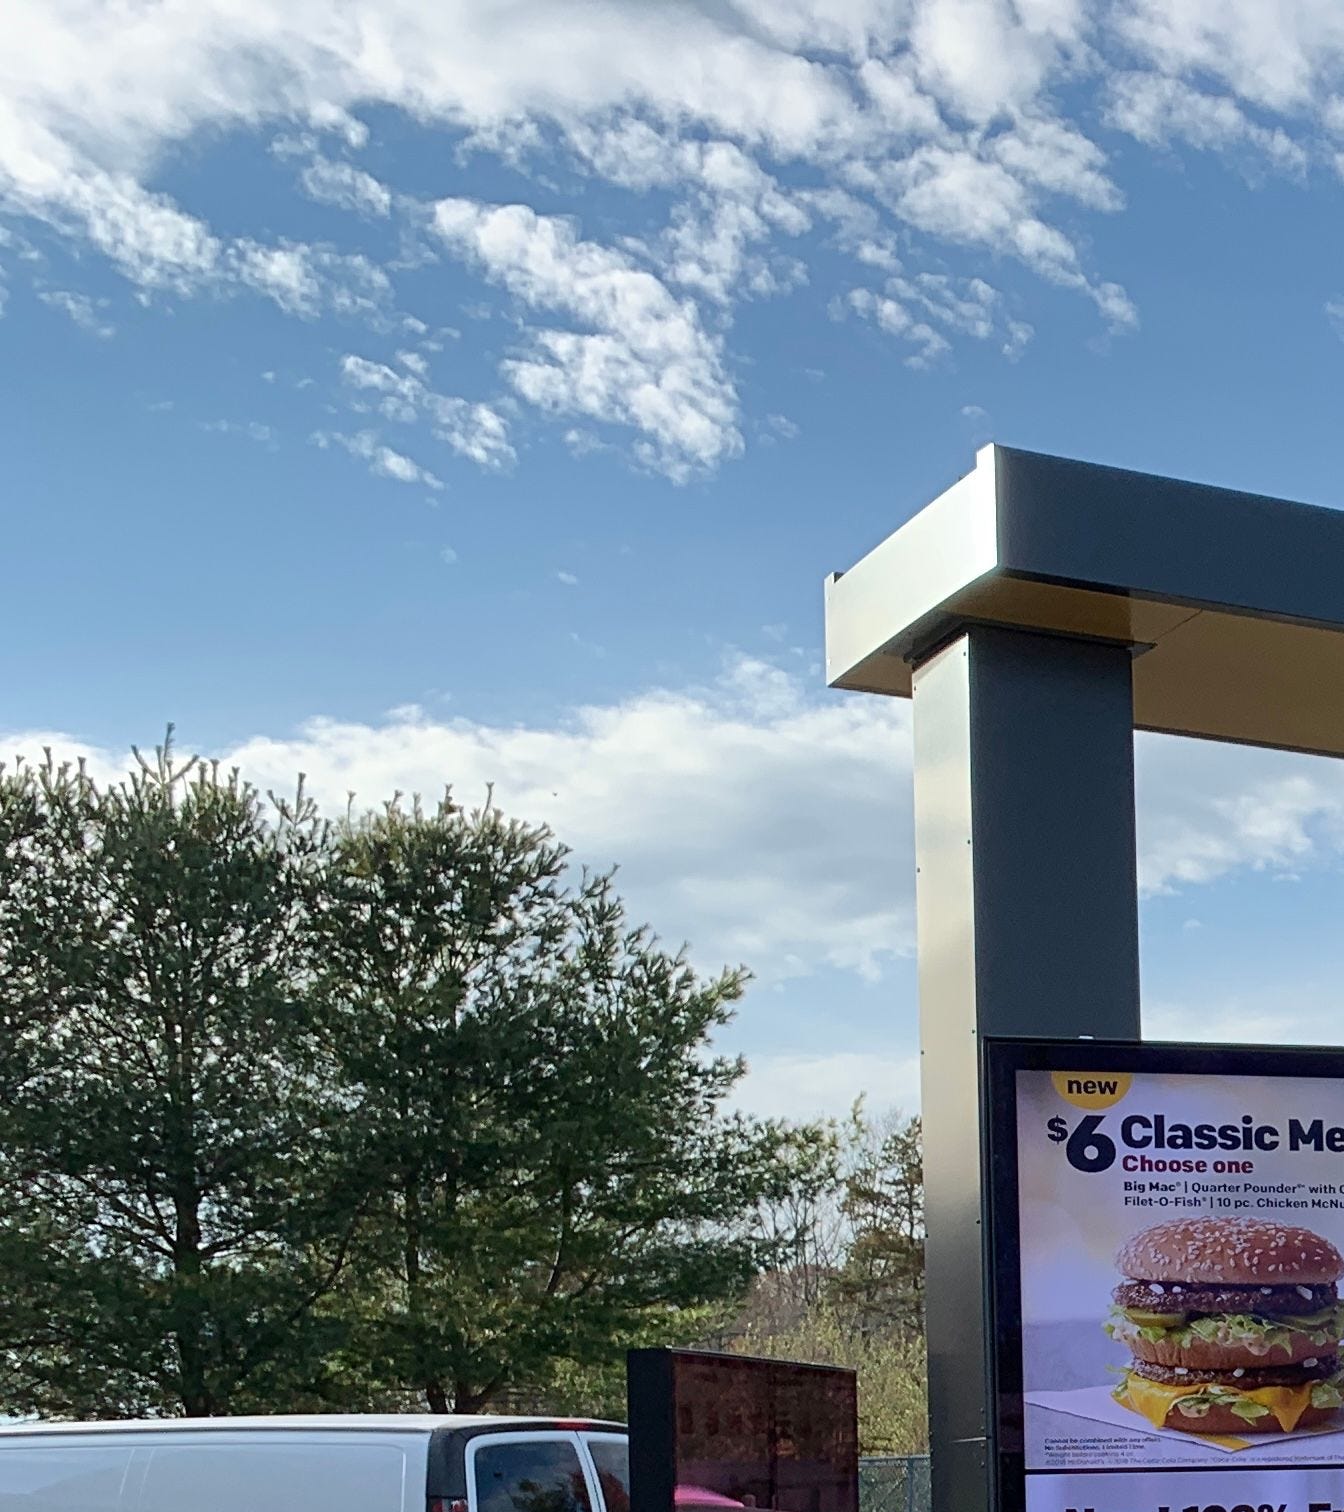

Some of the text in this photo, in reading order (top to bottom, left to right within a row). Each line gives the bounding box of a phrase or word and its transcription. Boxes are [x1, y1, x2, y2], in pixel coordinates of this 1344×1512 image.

[1067, 1077, 1118, 1097] new
[1047, 1115, 1117, 1173] $6
[1120, 1115, 1279, 1152] Classic
[1122, 1156, 1254, 1174] Choose one
[1124, 1181, 1145, 1194] Big
[1191, 1183, 1240, 1194] Quarter
[1309, 1184, 1337, 1194] with
[1218, 1197, 1232, 1208] 10
[1234, 1198, 1254, 1209] pc.
[1257, 1197, 1308, 1209] Chicken
